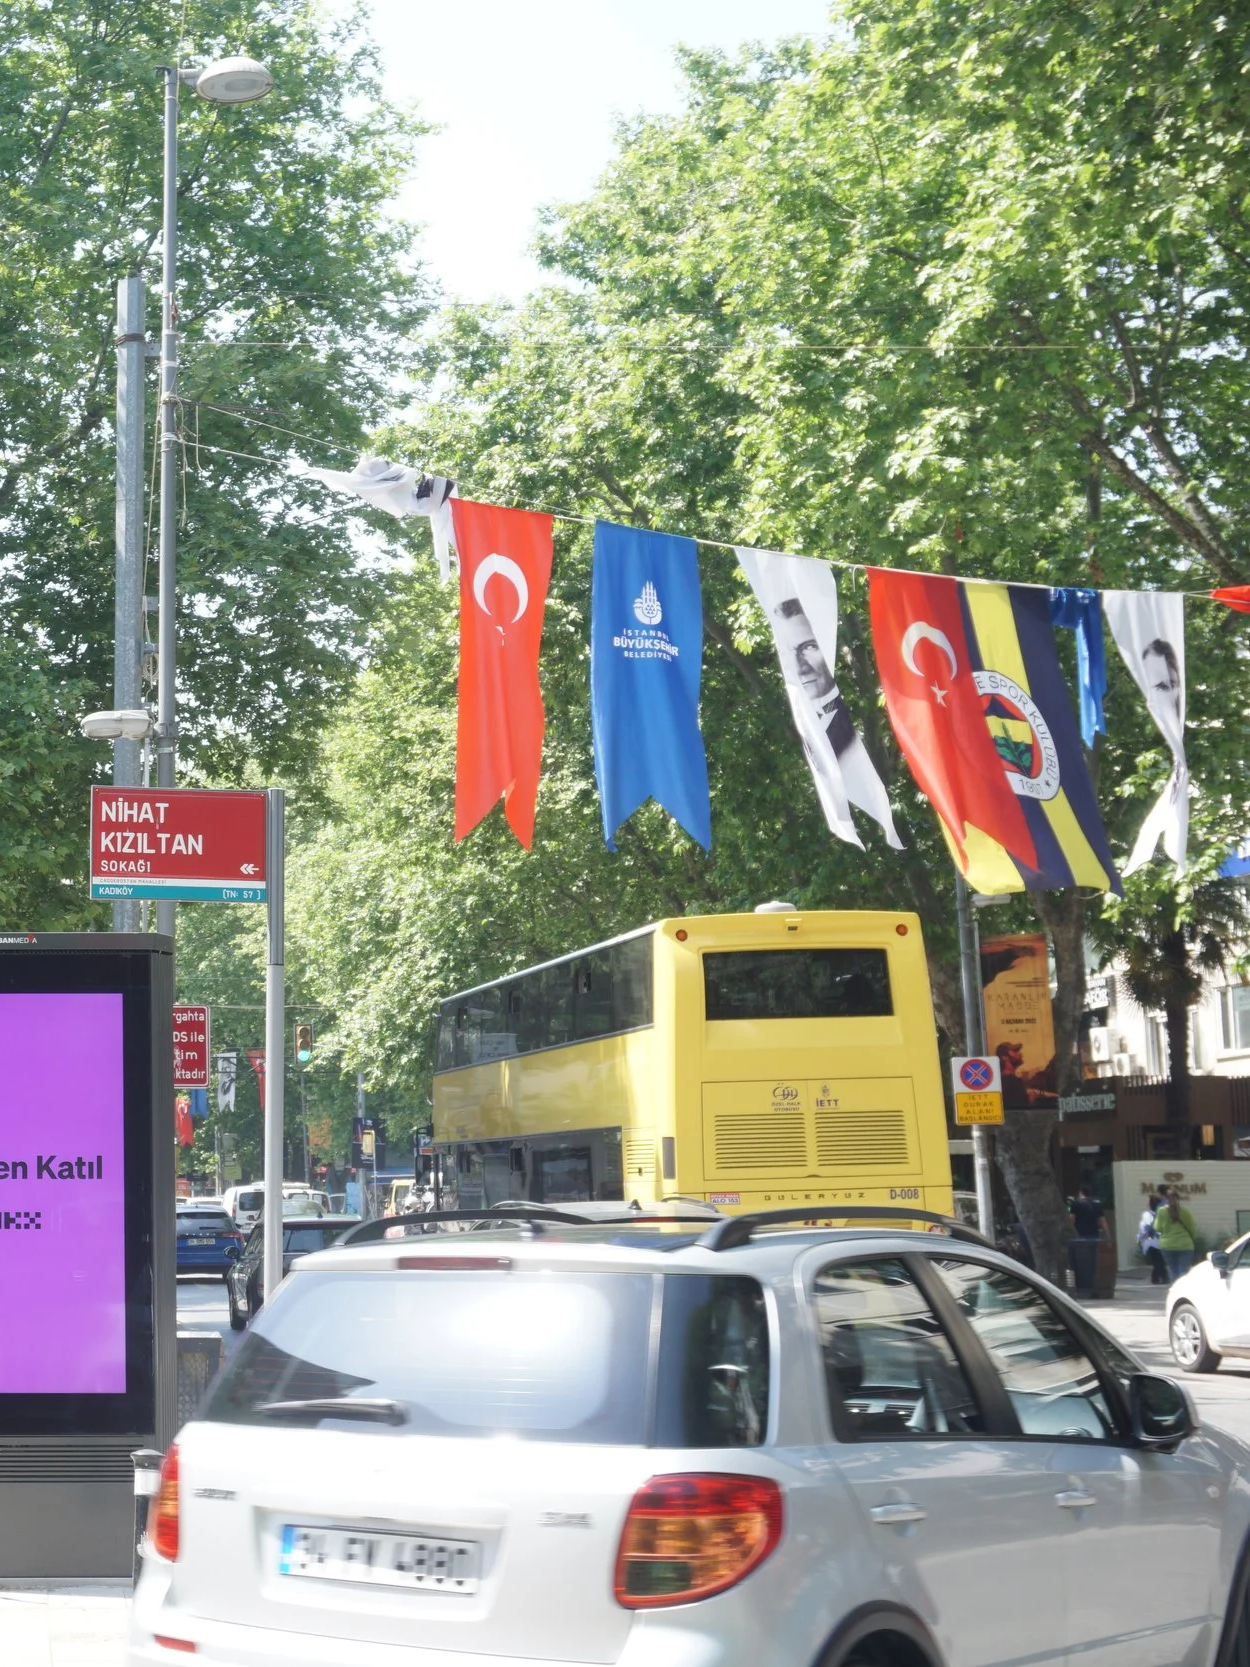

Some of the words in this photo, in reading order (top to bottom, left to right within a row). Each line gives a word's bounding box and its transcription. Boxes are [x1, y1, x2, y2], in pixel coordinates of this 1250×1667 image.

[613, 636, 679, 656] BÜYÜKŞEHİR
[988, 675, 1029, 710] SPOR
[101, 797, 170, 824] NİHAT
[100, 831, 203, 855] KIZILTAN
[100, 859, 151, 873] SOKAĞI
[99, 886, 133, 895] KADIKÖY
[190, 1032, 205, 1042] ile
[174, 1068, 206, 1079] ktadır
[36, 1155, 103, 1180] Katıl
[889, 1188, 920, 1200] D-008
